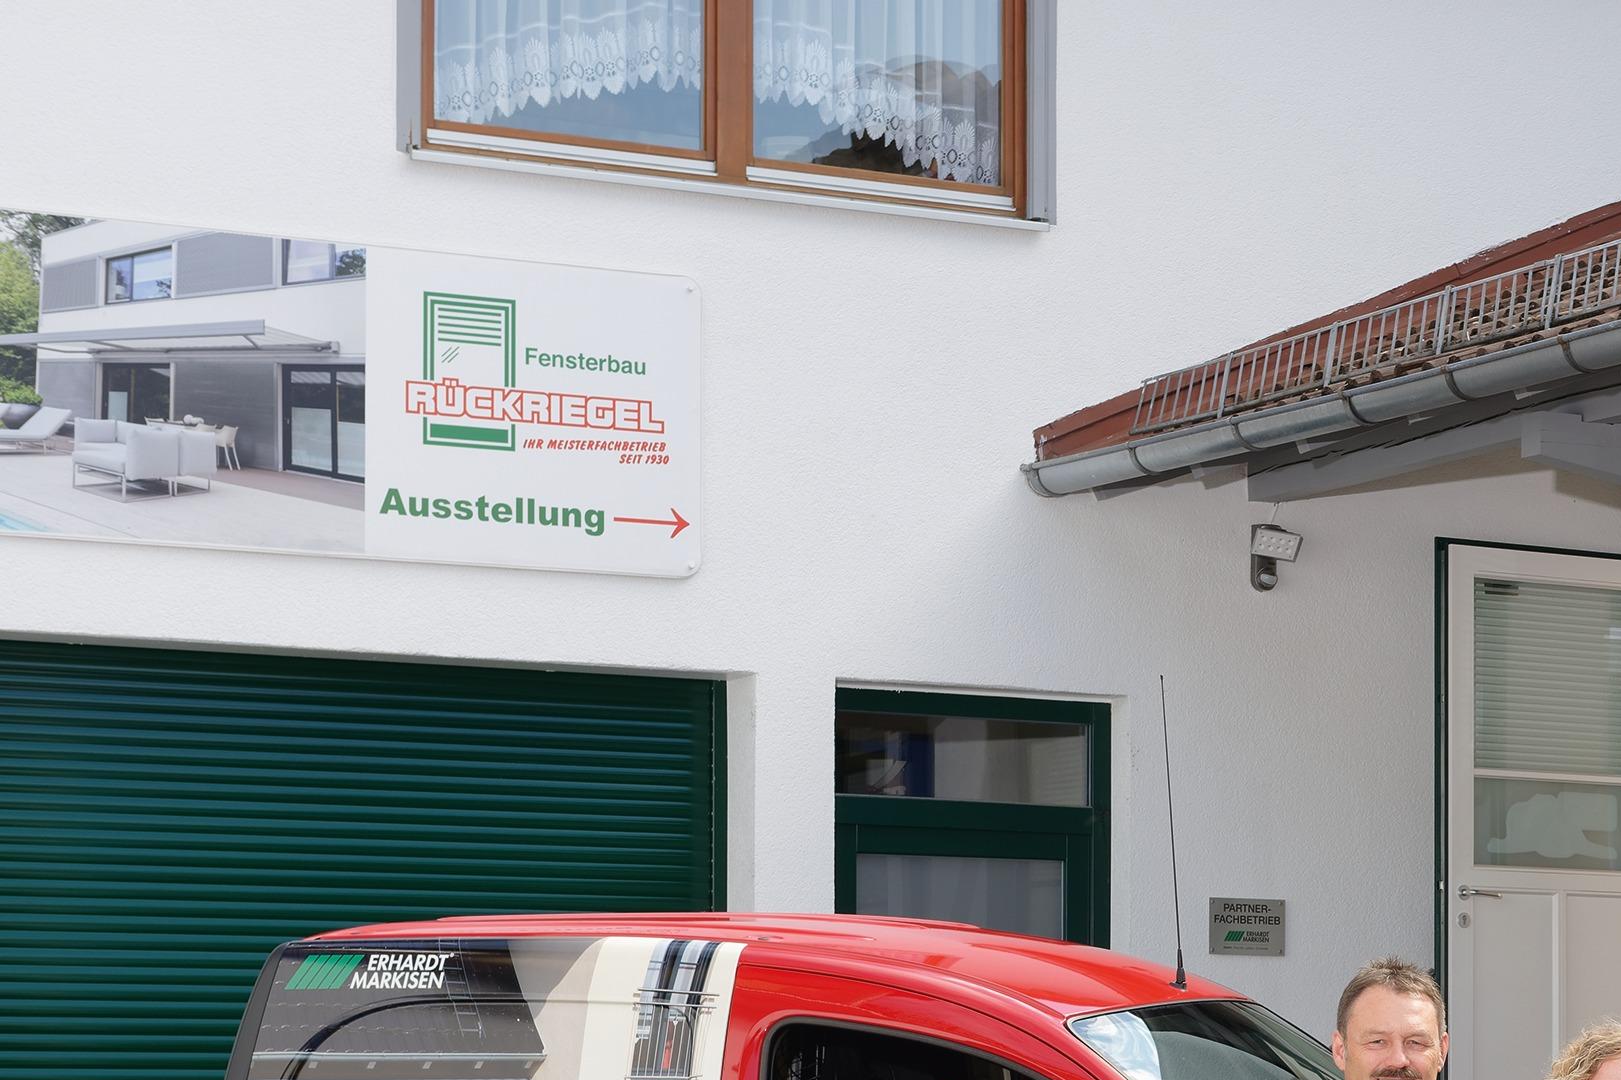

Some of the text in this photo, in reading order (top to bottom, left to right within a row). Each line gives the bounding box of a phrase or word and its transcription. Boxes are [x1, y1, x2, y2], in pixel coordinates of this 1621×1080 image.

[525, 347, 647, 375] Fensterbau
[405, 377, 665, 434] RÜCKRIEGEL
[523, 439, 667, 453] IHR MEISTERFACHBETRIEB
[619, 454, 670, 465] SEIT 1930
[379, 487, 606, 537] Ausstellung
[1223, 903, 1272, 914] PARTNER-
[1213, 914, 1281, 926] FACHBETRIEB
[367, 954, 450, 972] ERHARDT
[349, 971, 446, 990] MARKISEN
